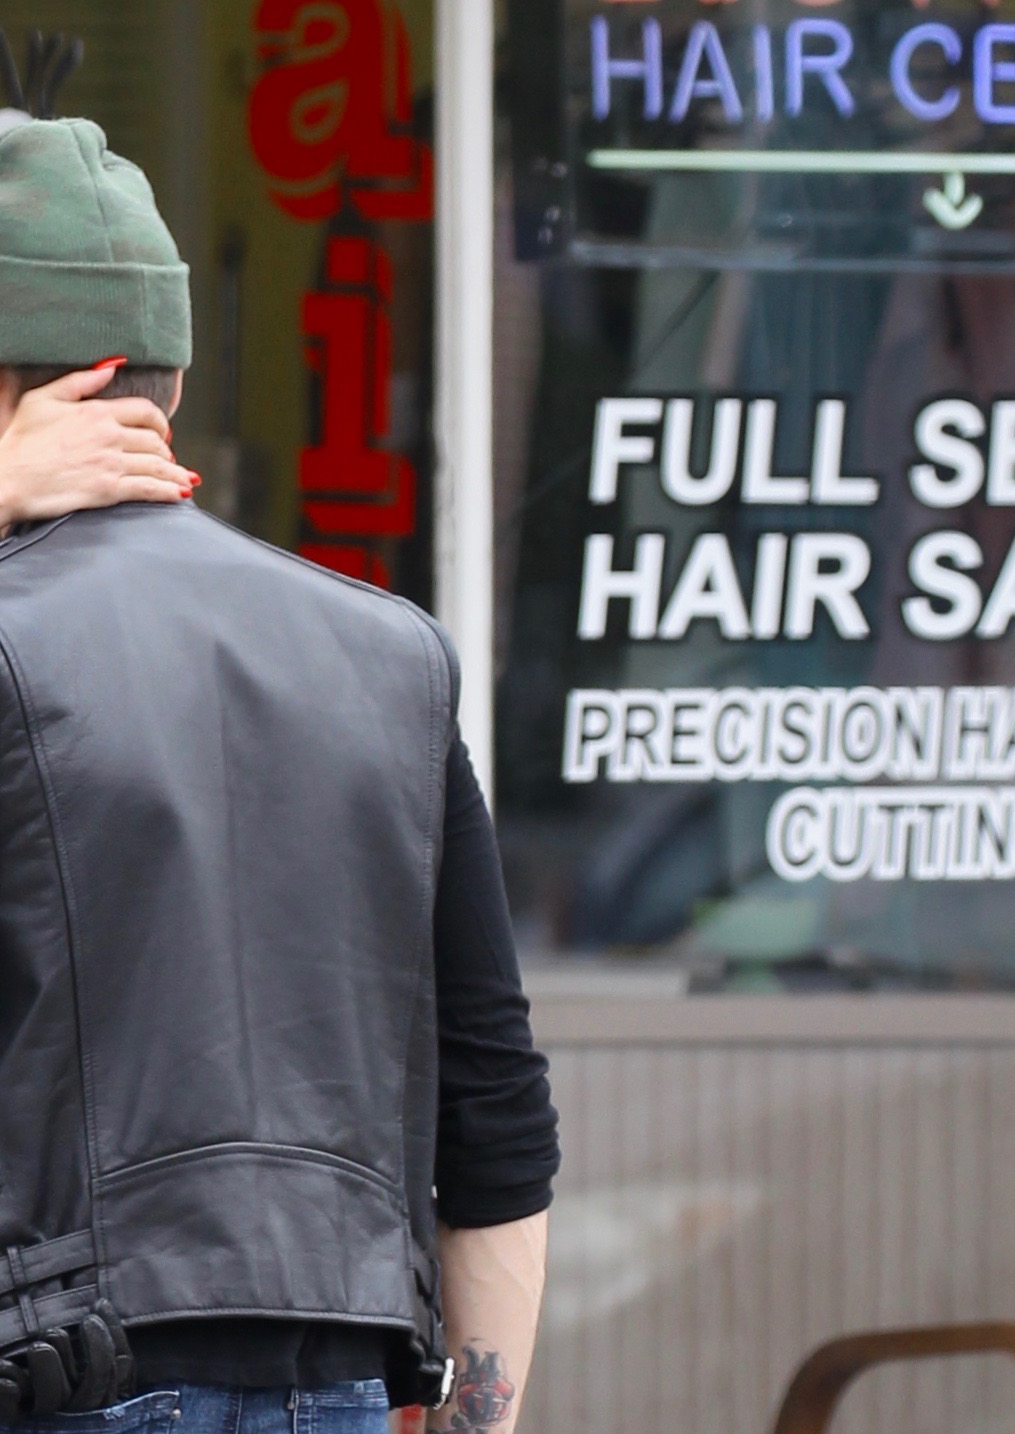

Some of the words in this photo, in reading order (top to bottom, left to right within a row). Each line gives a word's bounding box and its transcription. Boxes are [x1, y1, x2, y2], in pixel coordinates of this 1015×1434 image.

[590, 16, 856, 123] HAIR
[889, 22, 1015, 123] CE
[589, 398, 880, 506] FULL
[577, 532, 871, 640] HAIR
[562, 686, 944, 782] PRECISION
[765, 786, 1015, 882] CUTTIN
